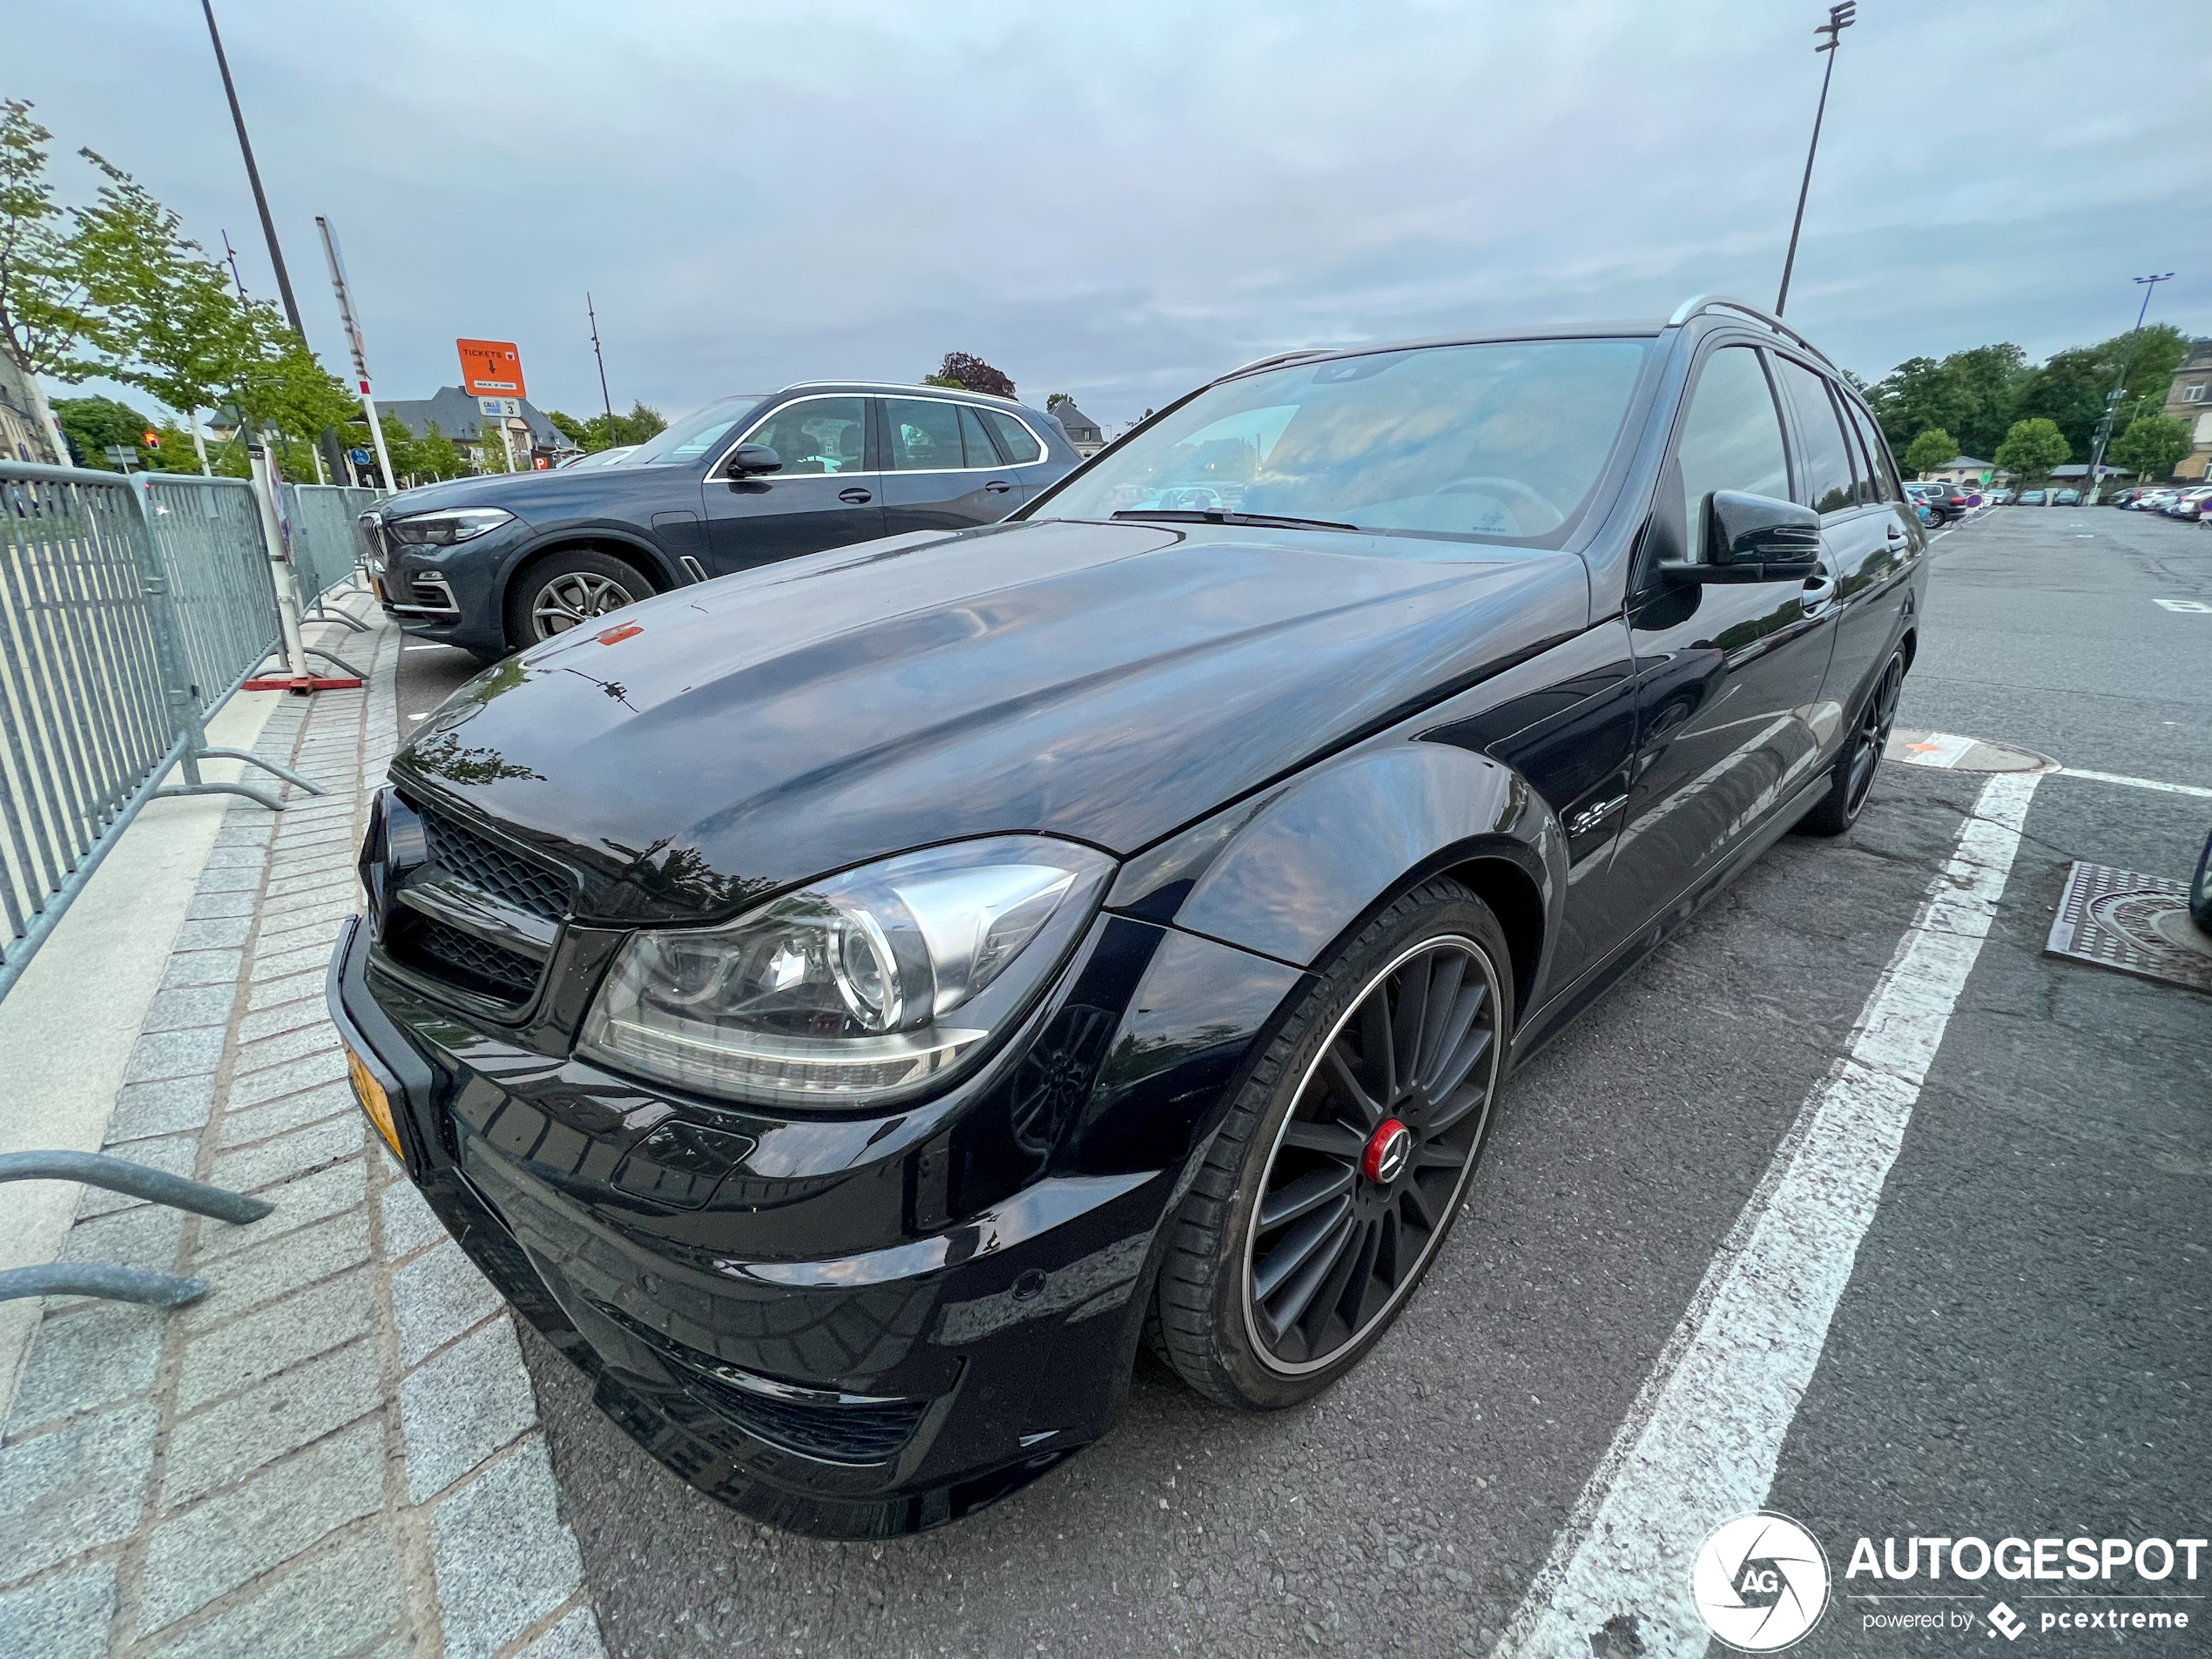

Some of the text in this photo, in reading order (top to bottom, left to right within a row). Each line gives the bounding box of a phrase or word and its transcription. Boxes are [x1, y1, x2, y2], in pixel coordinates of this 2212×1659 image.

[463, 348, 502, 359] TICKETS
[508, 406, 514, 415] 3
[536, 458, 544, 469] P
